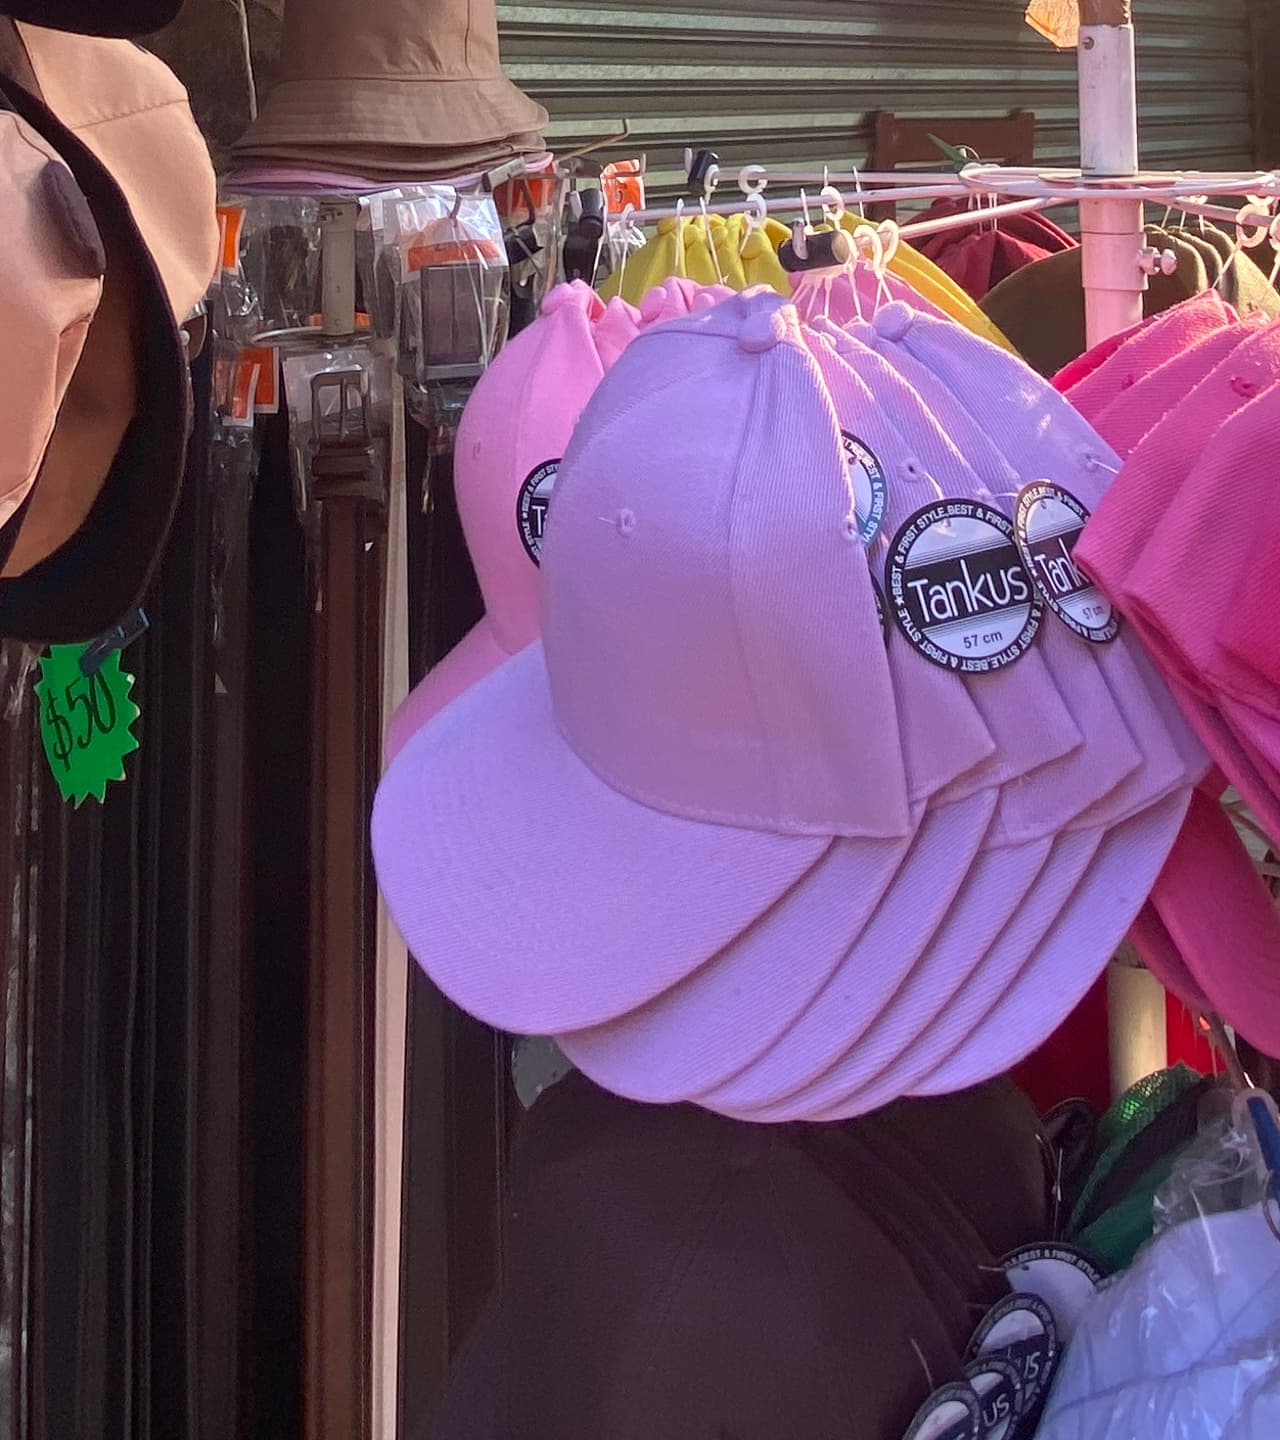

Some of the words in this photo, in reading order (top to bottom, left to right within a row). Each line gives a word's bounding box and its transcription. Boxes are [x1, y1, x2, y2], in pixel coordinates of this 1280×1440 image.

[897, 525, 919, 554] FIRST
[985, 513, 1014, 536] FIRST
[891, 565, 904, 596] BEST
[1034, 537, 1090, 595] Tank
[907, 558, 1028, 623] Tankus
[897, 607, 922, 641] STYLE
[1019, 620, 1041, 650] FIRST
[919, 640, 948, 665] FIRST
[963, 634, 979, 649] 57
[982, 631, 1004, 645] cm
[46, 672, 117, 772] $50
